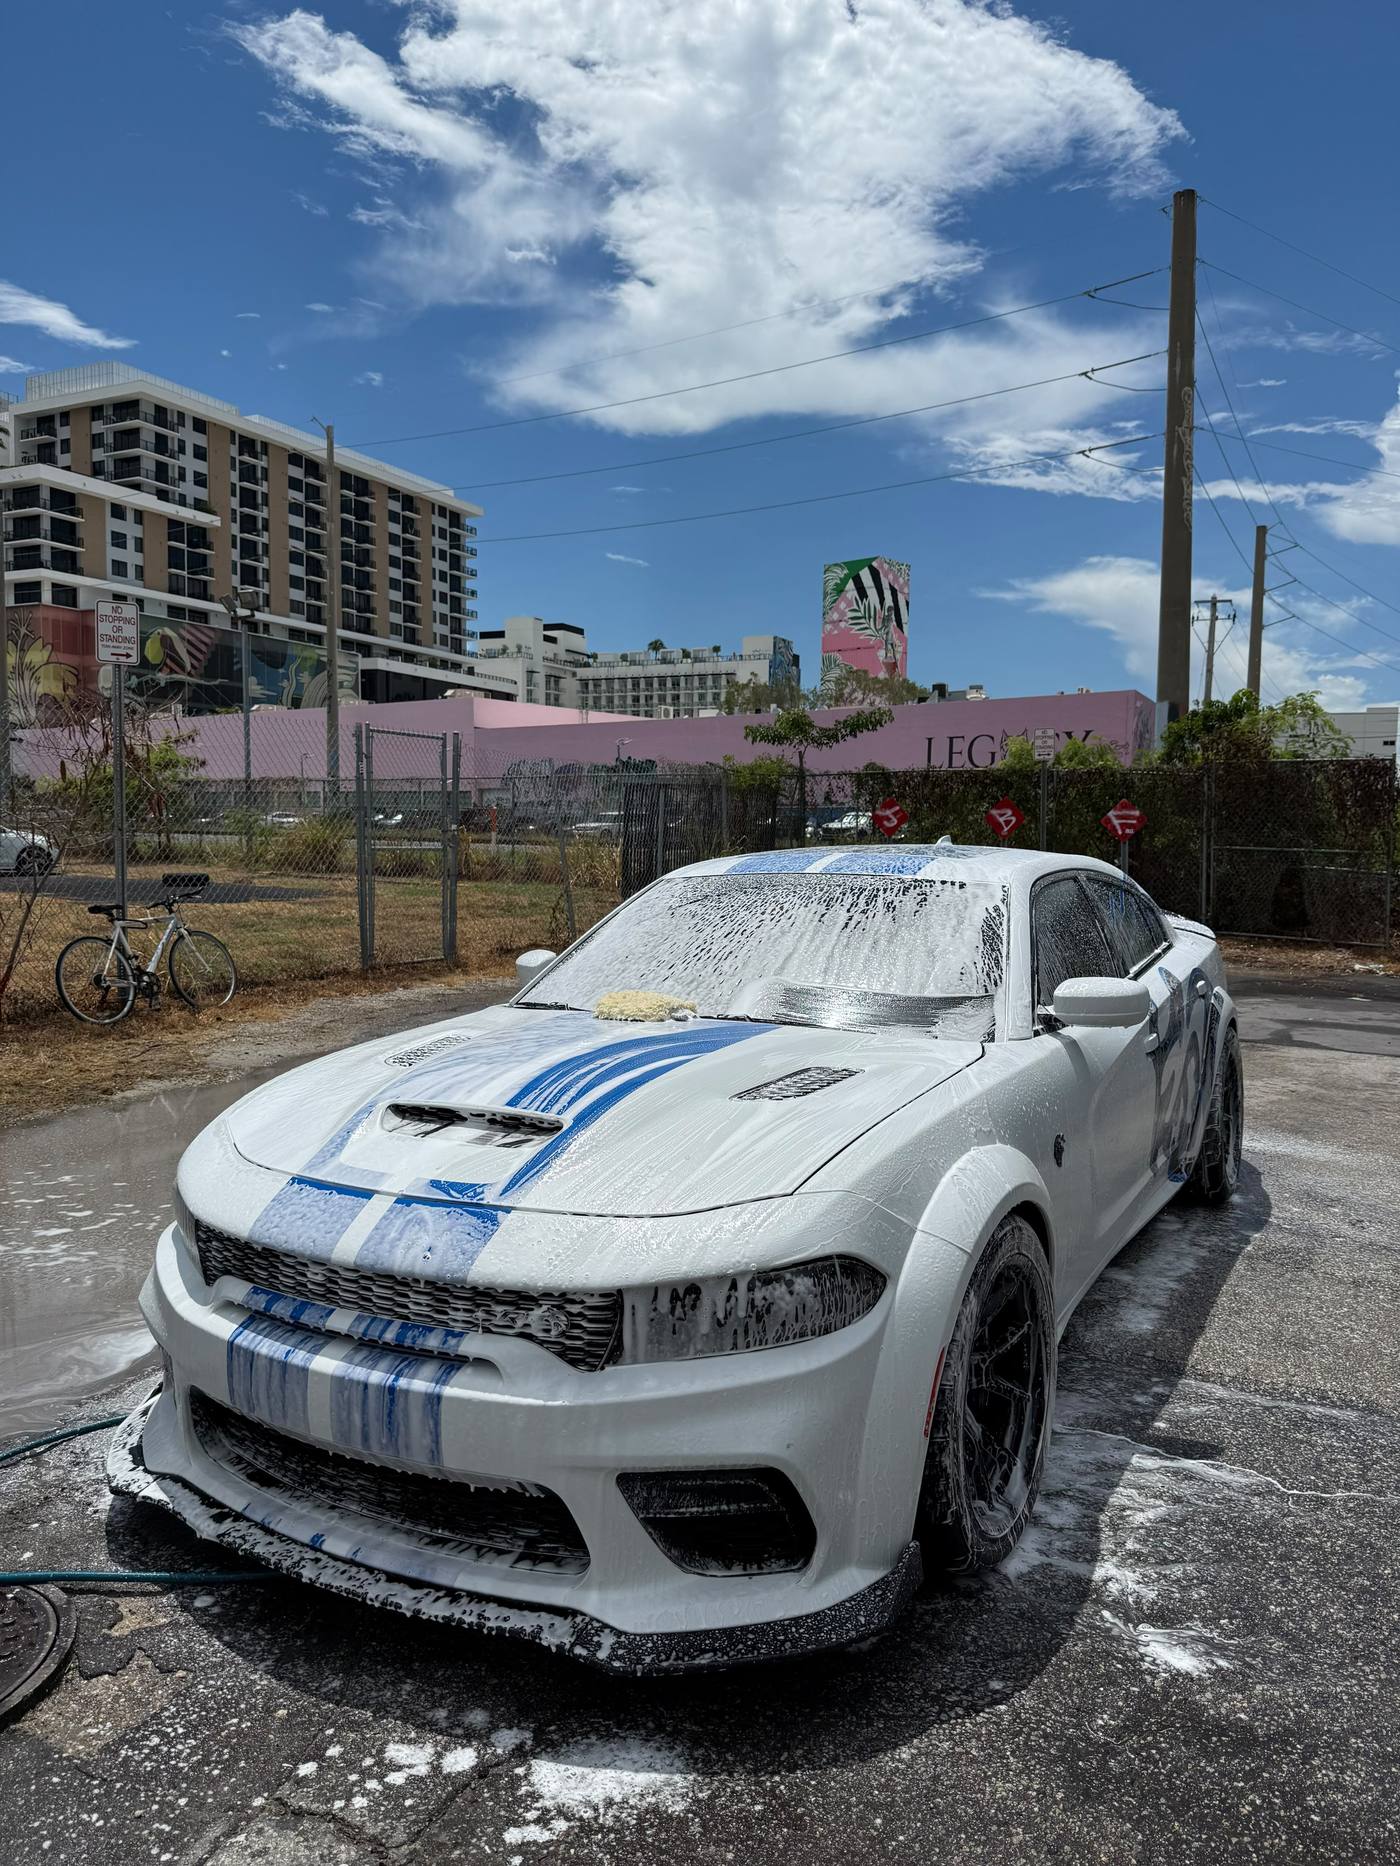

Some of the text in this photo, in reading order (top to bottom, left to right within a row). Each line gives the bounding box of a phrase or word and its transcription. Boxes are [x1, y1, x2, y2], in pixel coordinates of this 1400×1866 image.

[112, 606, 123, 615] NO
[99, 615, 136, 625] STOPPING
[112, 625, 123, 634] OR
[100, 634, 136, 645] STANDING
